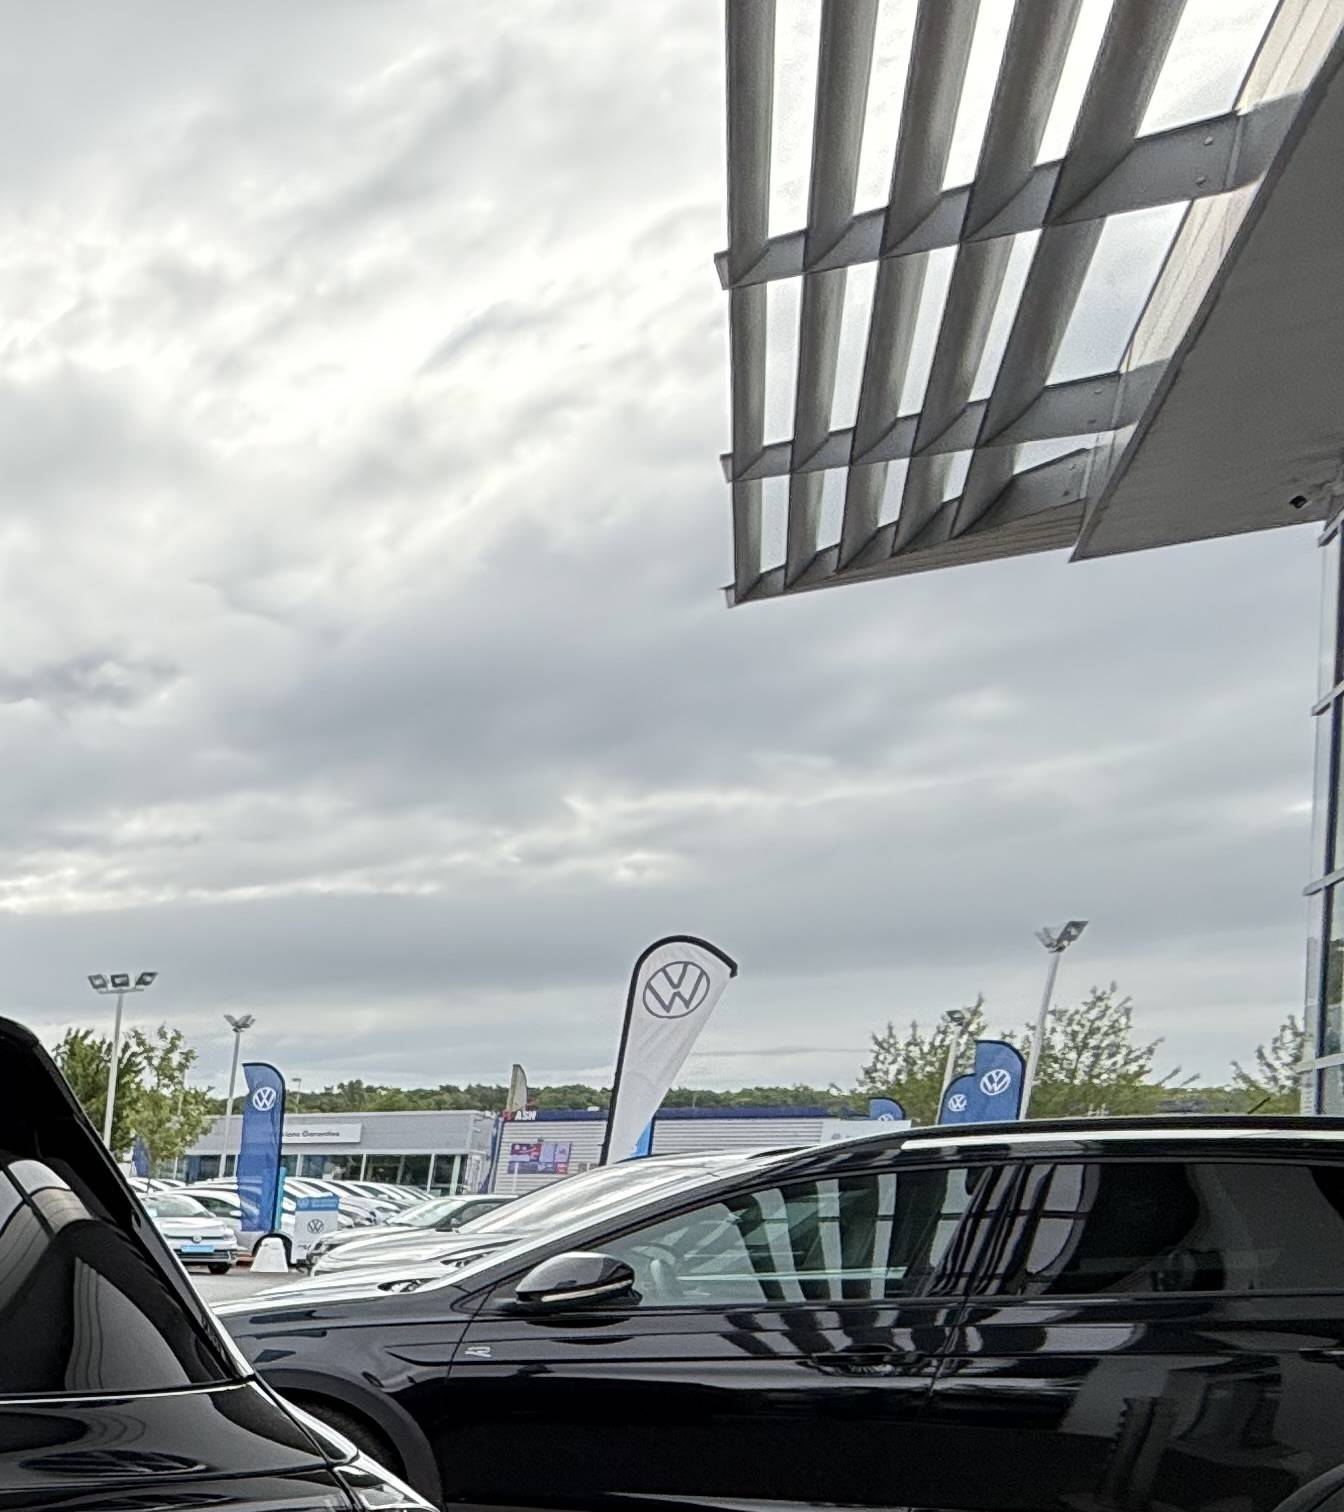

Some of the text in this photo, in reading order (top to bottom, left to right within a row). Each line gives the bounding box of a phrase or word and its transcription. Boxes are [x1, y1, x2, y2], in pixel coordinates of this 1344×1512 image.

[642, 961, 711, 1019] VW
[980, 1069, 1011, 1096] VW
[252, 1087, 277, 1111] VW
